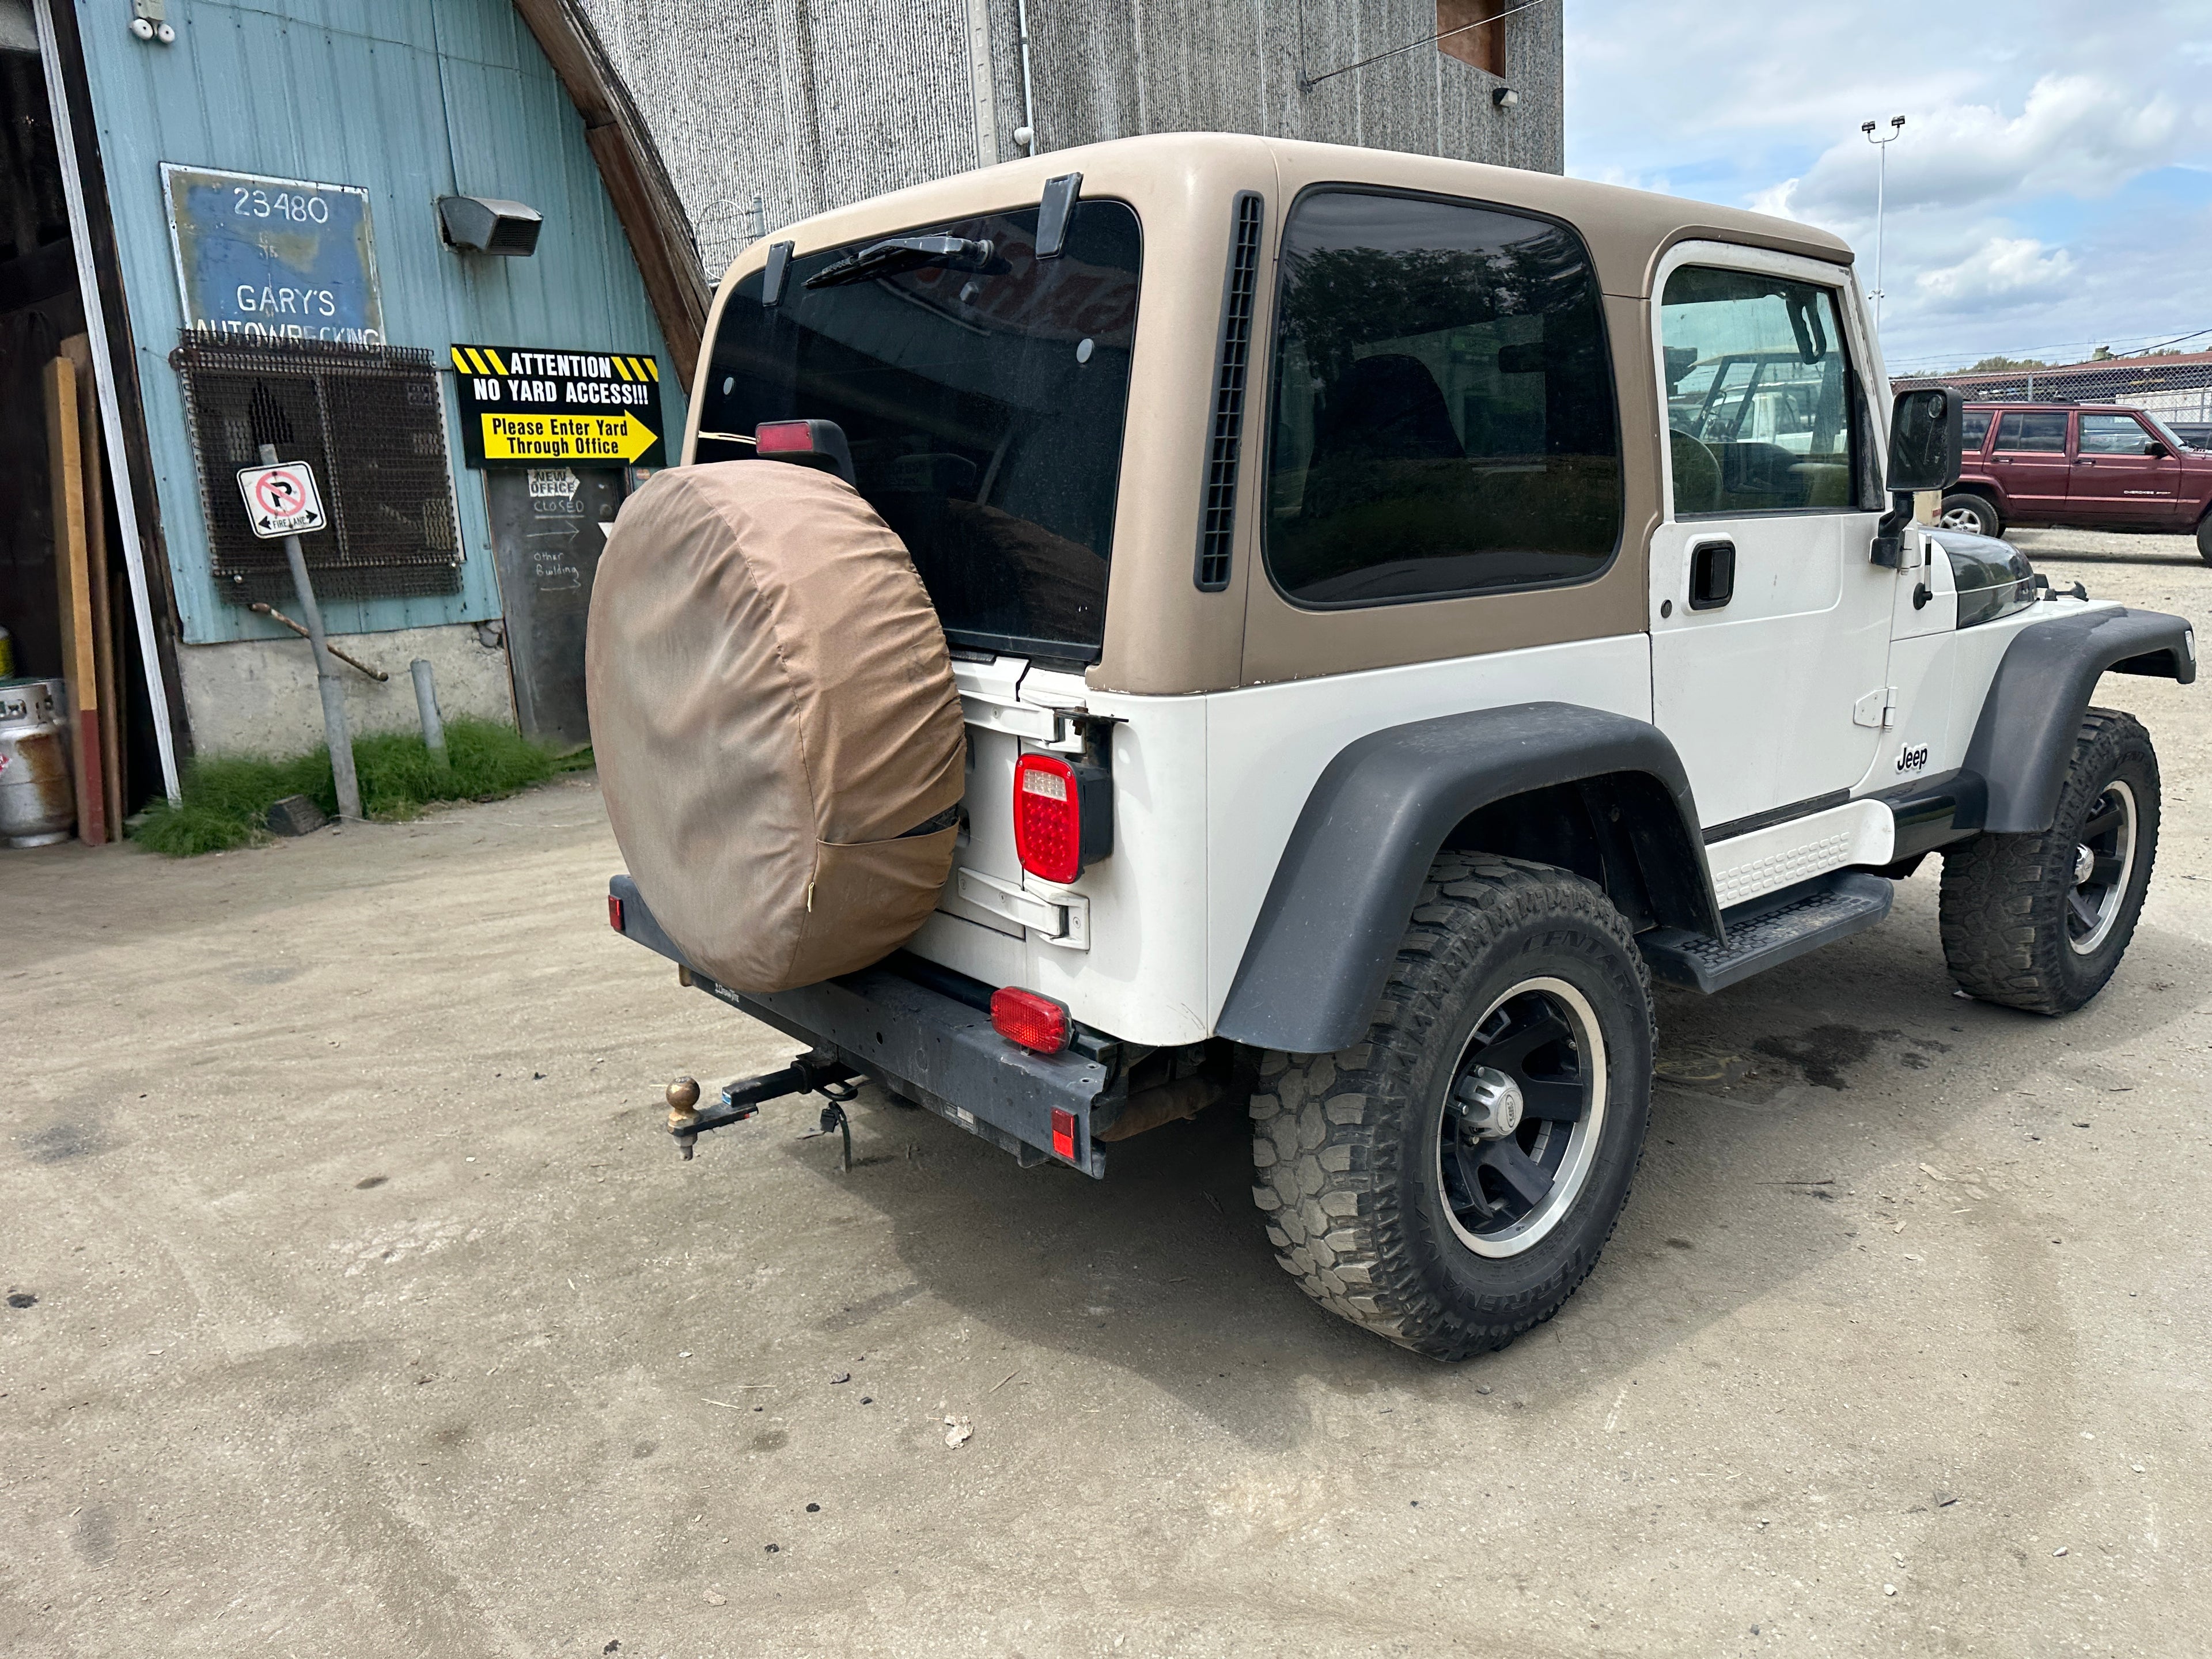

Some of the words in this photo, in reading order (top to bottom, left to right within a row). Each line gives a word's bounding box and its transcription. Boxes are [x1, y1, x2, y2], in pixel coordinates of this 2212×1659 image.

[234, 187, 328, 224] 23480
[237, 285, 335, 316] GARY'S
[511, 353, 611, 378] ATTENTION
[474, 378, 501, 400] NO
[507, 380, 557, 402] YARD
[566, 382, 648, 404] ACCESS!!!
[493, 418, 543, 435] Please
[550, 419, 589, 435] Enter
[596, 419, 627, 436] Yard
[507, 437, 569, 456] Through
[575, 439, 619, 453] Office
[536, 471, 566, 482] NEW
[531, 482, 575, 494] OFFICE
[534, 500, 584, 513] CLOSED
[272, 518, 287, 529] FIRE
[1897, 747, 1928, 771] Jeep
